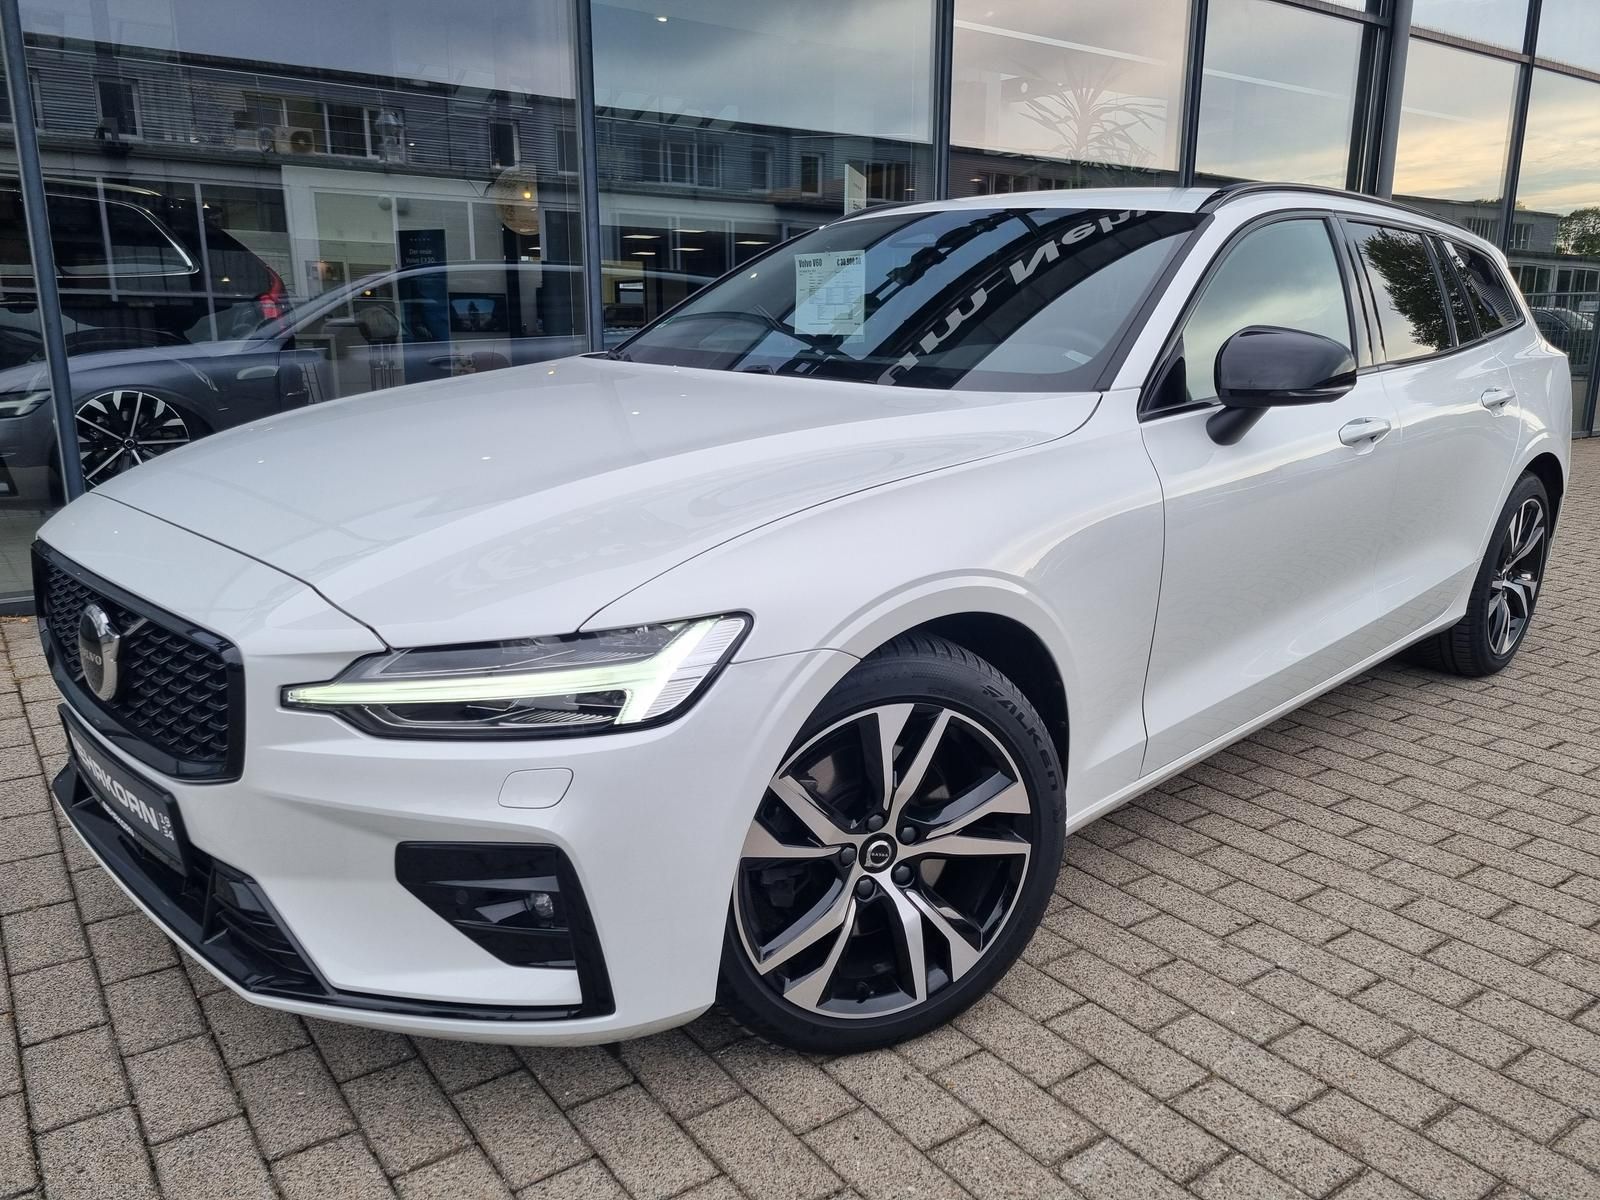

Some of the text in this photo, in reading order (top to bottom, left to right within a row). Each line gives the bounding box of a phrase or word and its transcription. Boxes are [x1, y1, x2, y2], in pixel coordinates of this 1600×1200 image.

[799, 258, 822, 268] Volvo V60
[981, 685, 1058, 791] FALKEN
